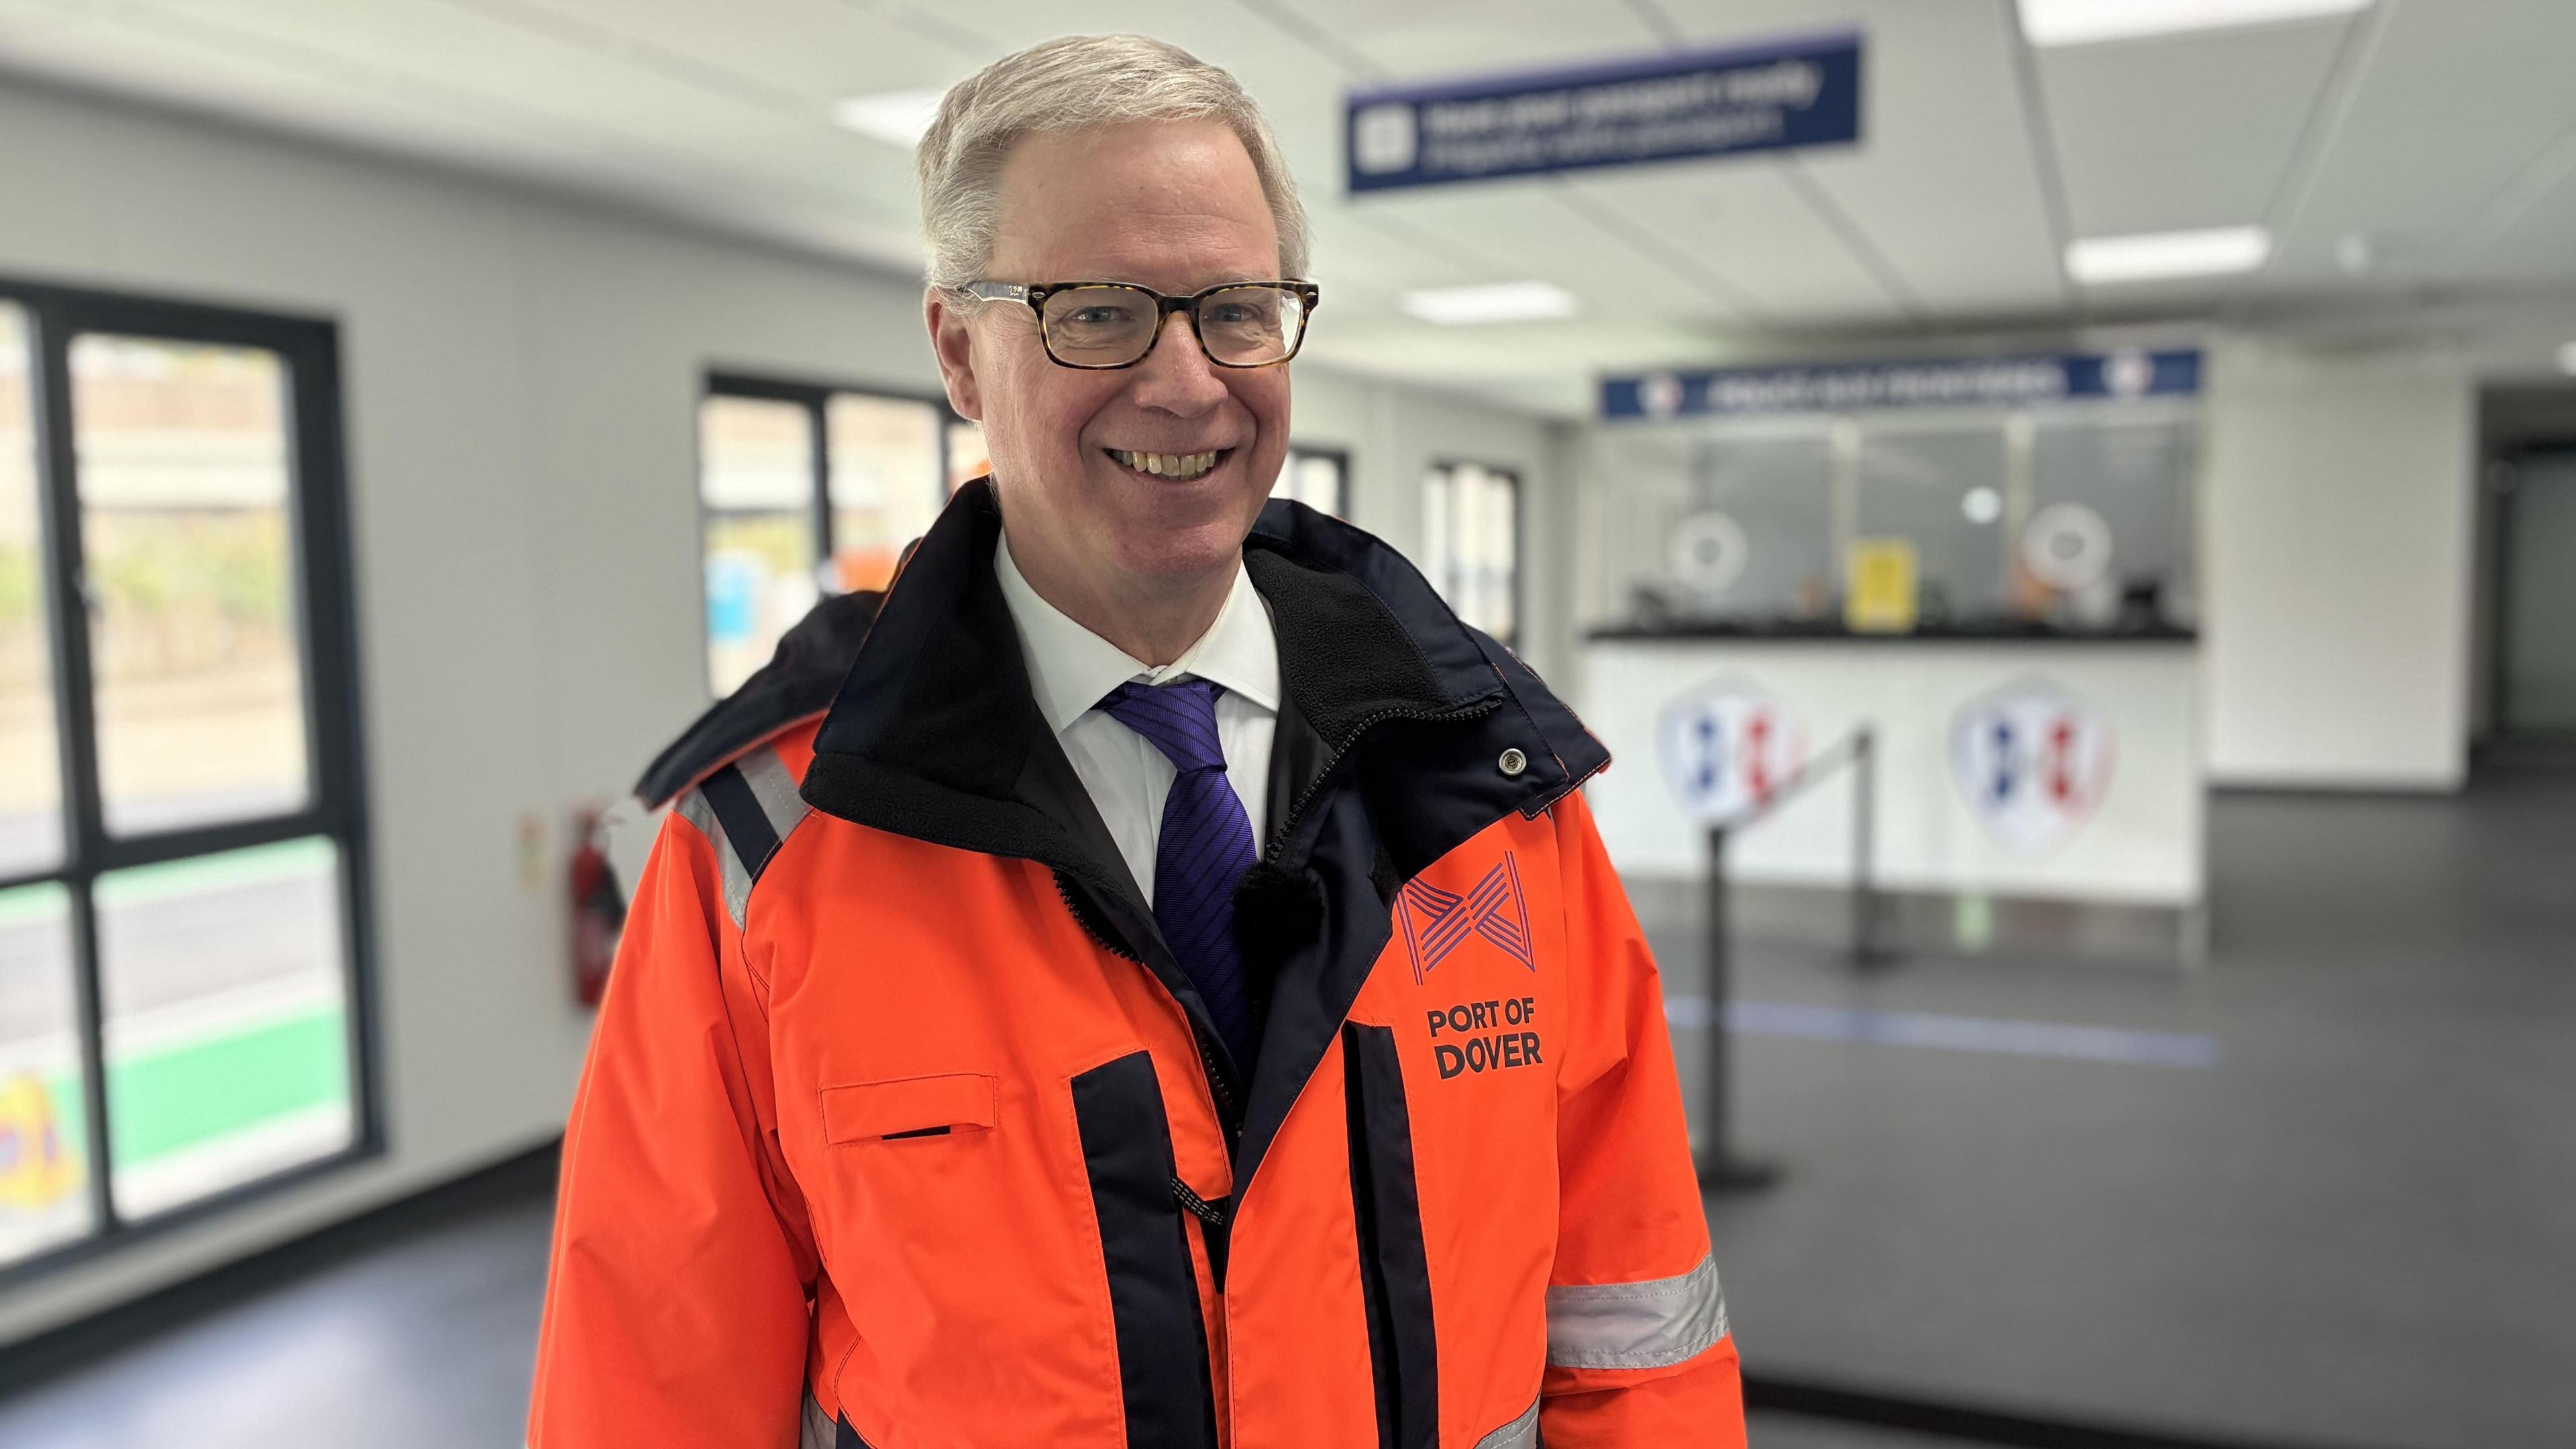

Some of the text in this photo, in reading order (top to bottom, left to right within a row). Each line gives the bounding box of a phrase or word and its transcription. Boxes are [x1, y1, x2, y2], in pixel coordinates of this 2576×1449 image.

[1428, 998, 1534, 1038] PORT OF
[1434, 1032, 1543, 1080] DOVER
